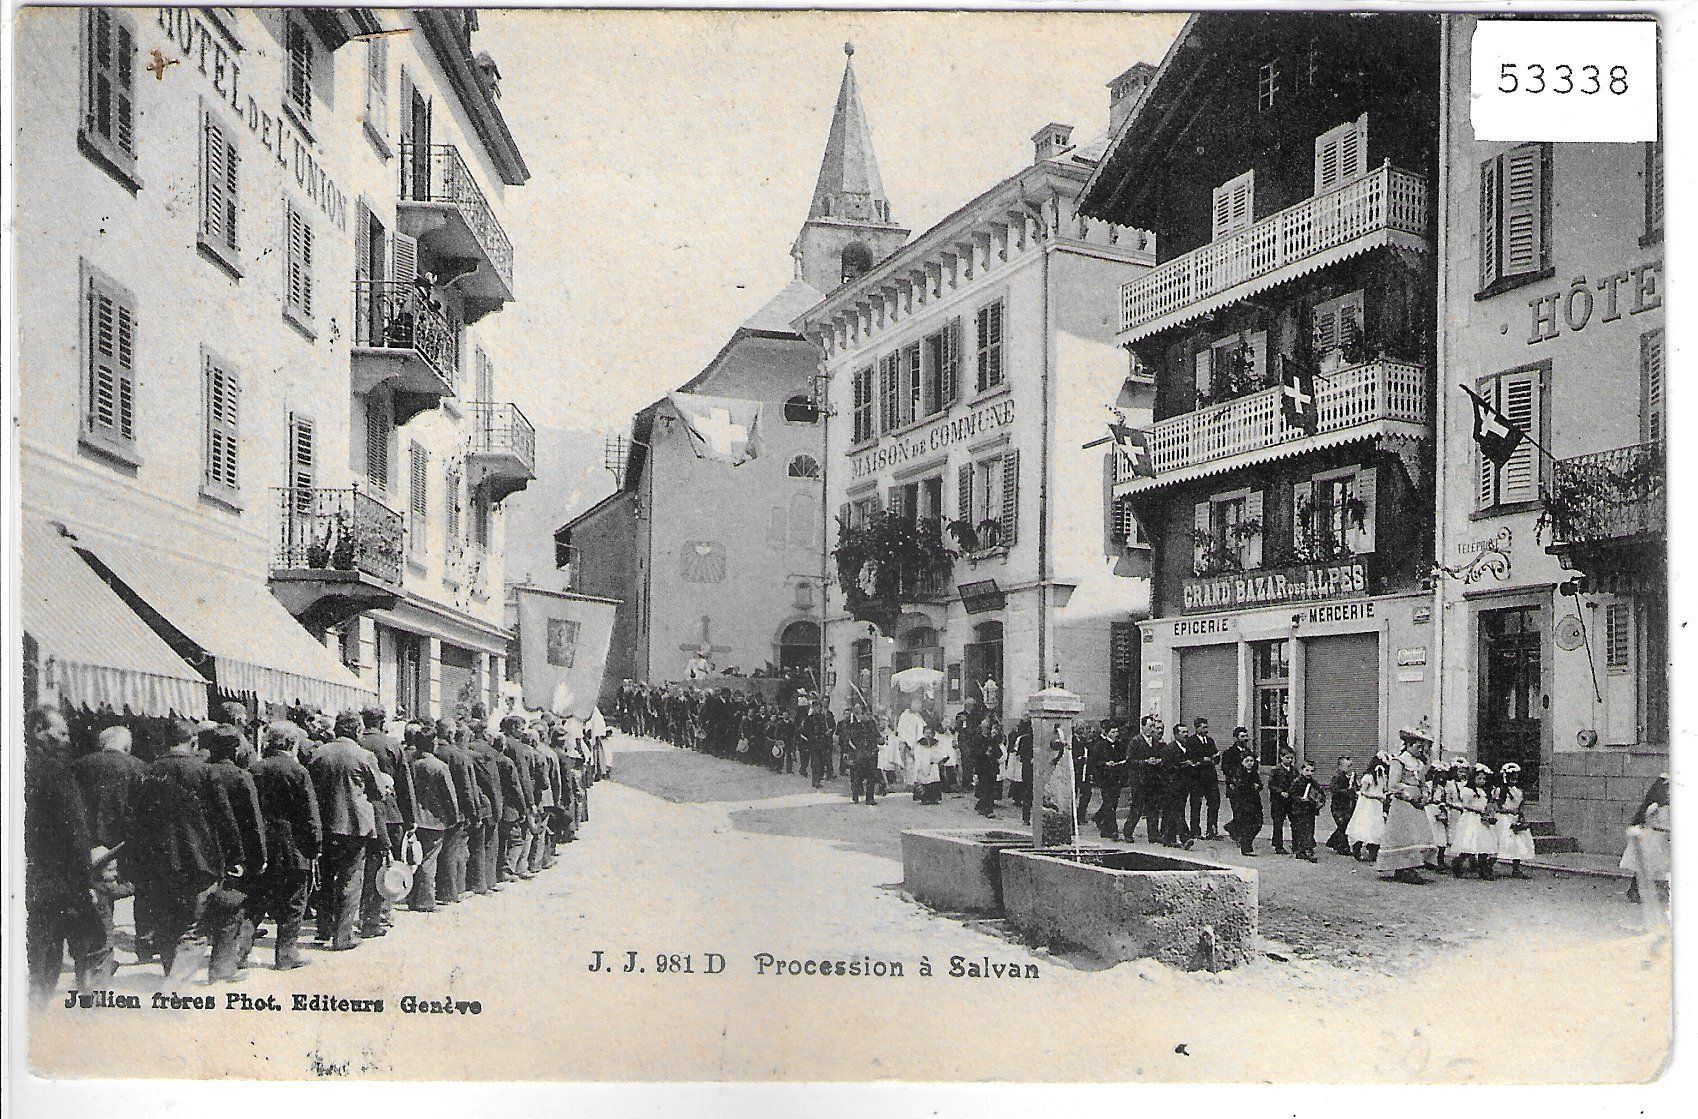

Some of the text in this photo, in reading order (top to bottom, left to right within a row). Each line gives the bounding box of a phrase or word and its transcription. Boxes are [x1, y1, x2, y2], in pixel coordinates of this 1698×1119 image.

[851, 399, 1016, 478] MAISON DE COMMUNE
[1183, 564, 1364, 609] GRAND BAZAR DES ALPES
[1174, 619, 1229, 636] EPICERIE
[1309, 603, 1375, 623] MERCERIE
